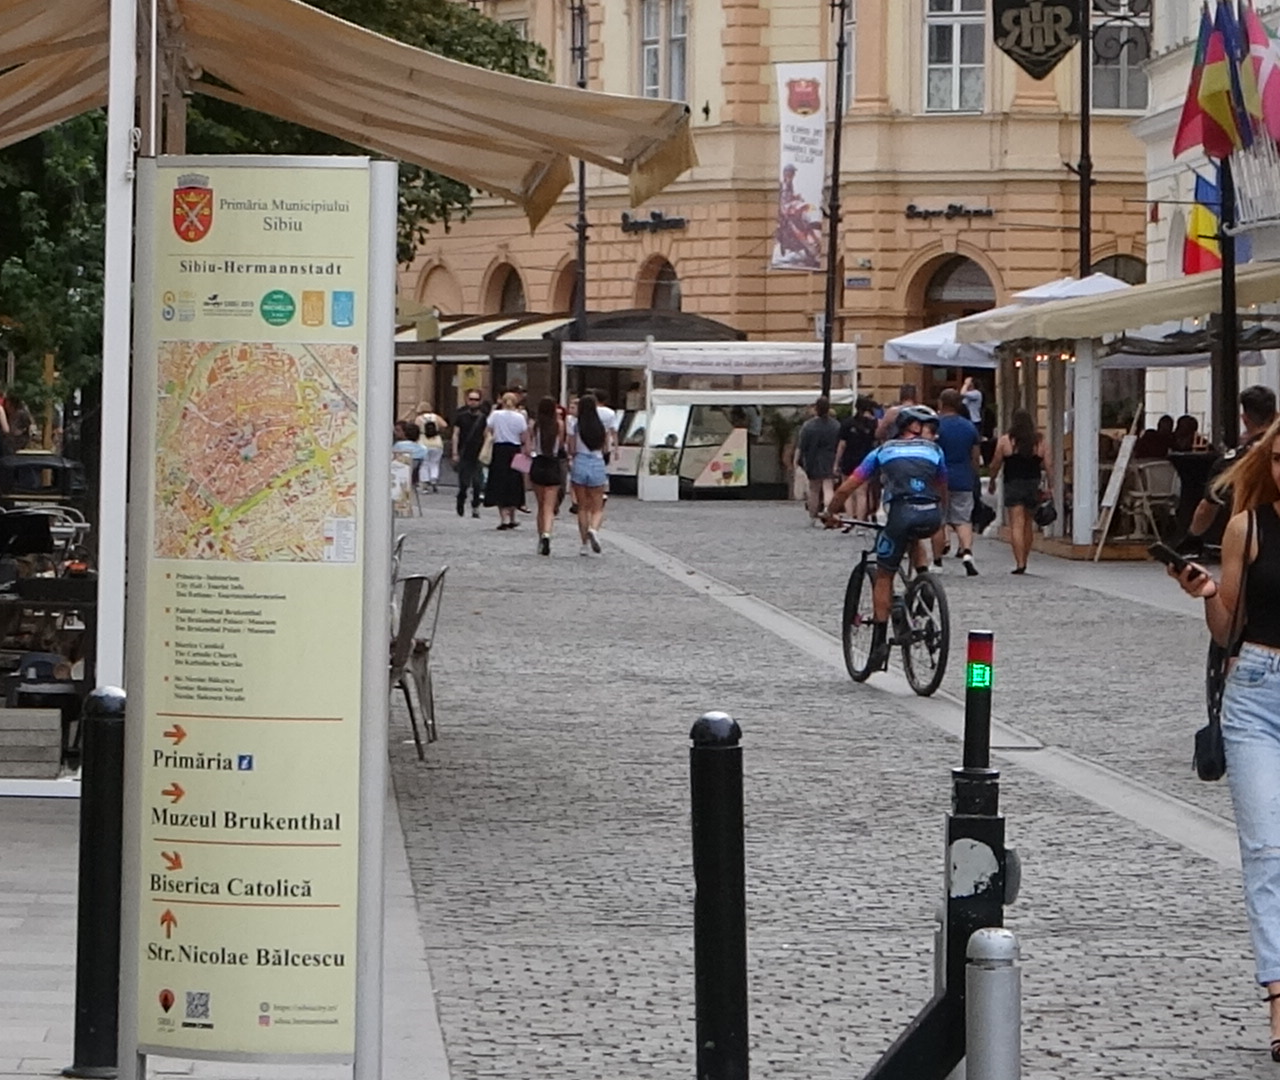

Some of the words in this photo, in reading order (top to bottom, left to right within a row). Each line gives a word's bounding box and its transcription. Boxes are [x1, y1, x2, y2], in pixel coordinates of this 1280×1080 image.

[271, 199, 350, 214] Municipiului
[262, 216, 303, 232] Sibiu
[179, 259, 342, 275] Sibiu-Hermannstadt
[152, 750, 233, 771] Primăria
[151, 807, 216, 828] Muzeul
[223, 811, 341, 831] Brukenthal
[150, 873, 220, 895] Biserica
[227, 876, 312, 898] Catolică
[147, 942, 175, 962] Str.
[178, 944, 249, 966] Nicolae
[256, 947, 346, 967] Bălcescu
